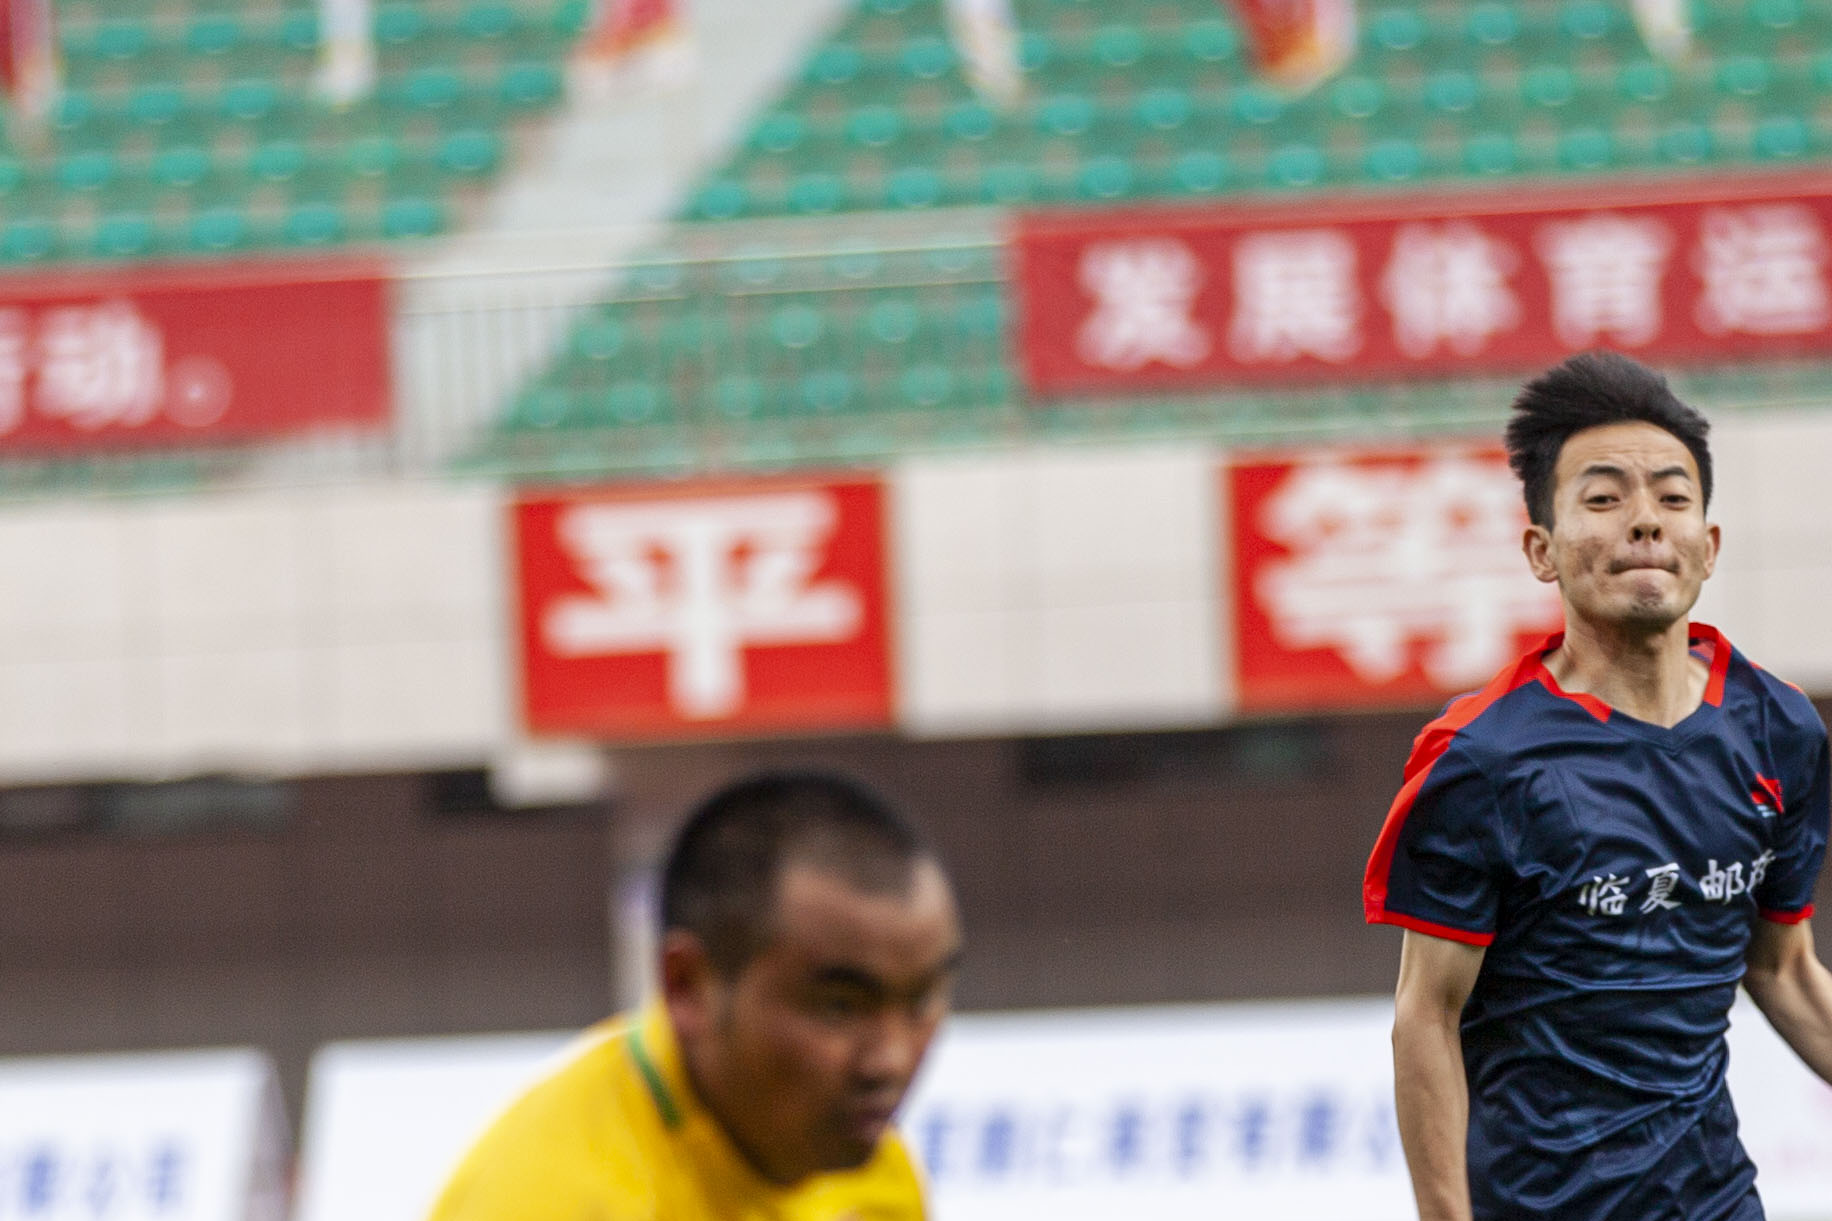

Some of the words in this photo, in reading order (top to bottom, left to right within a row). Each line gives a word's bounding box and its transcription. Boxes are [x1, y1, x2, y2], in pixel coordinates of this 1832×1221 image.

[0, 300, 232, 434] 动。
[541, 492, 862, 718] 平
[1257, 462, 1562, 690] 等
